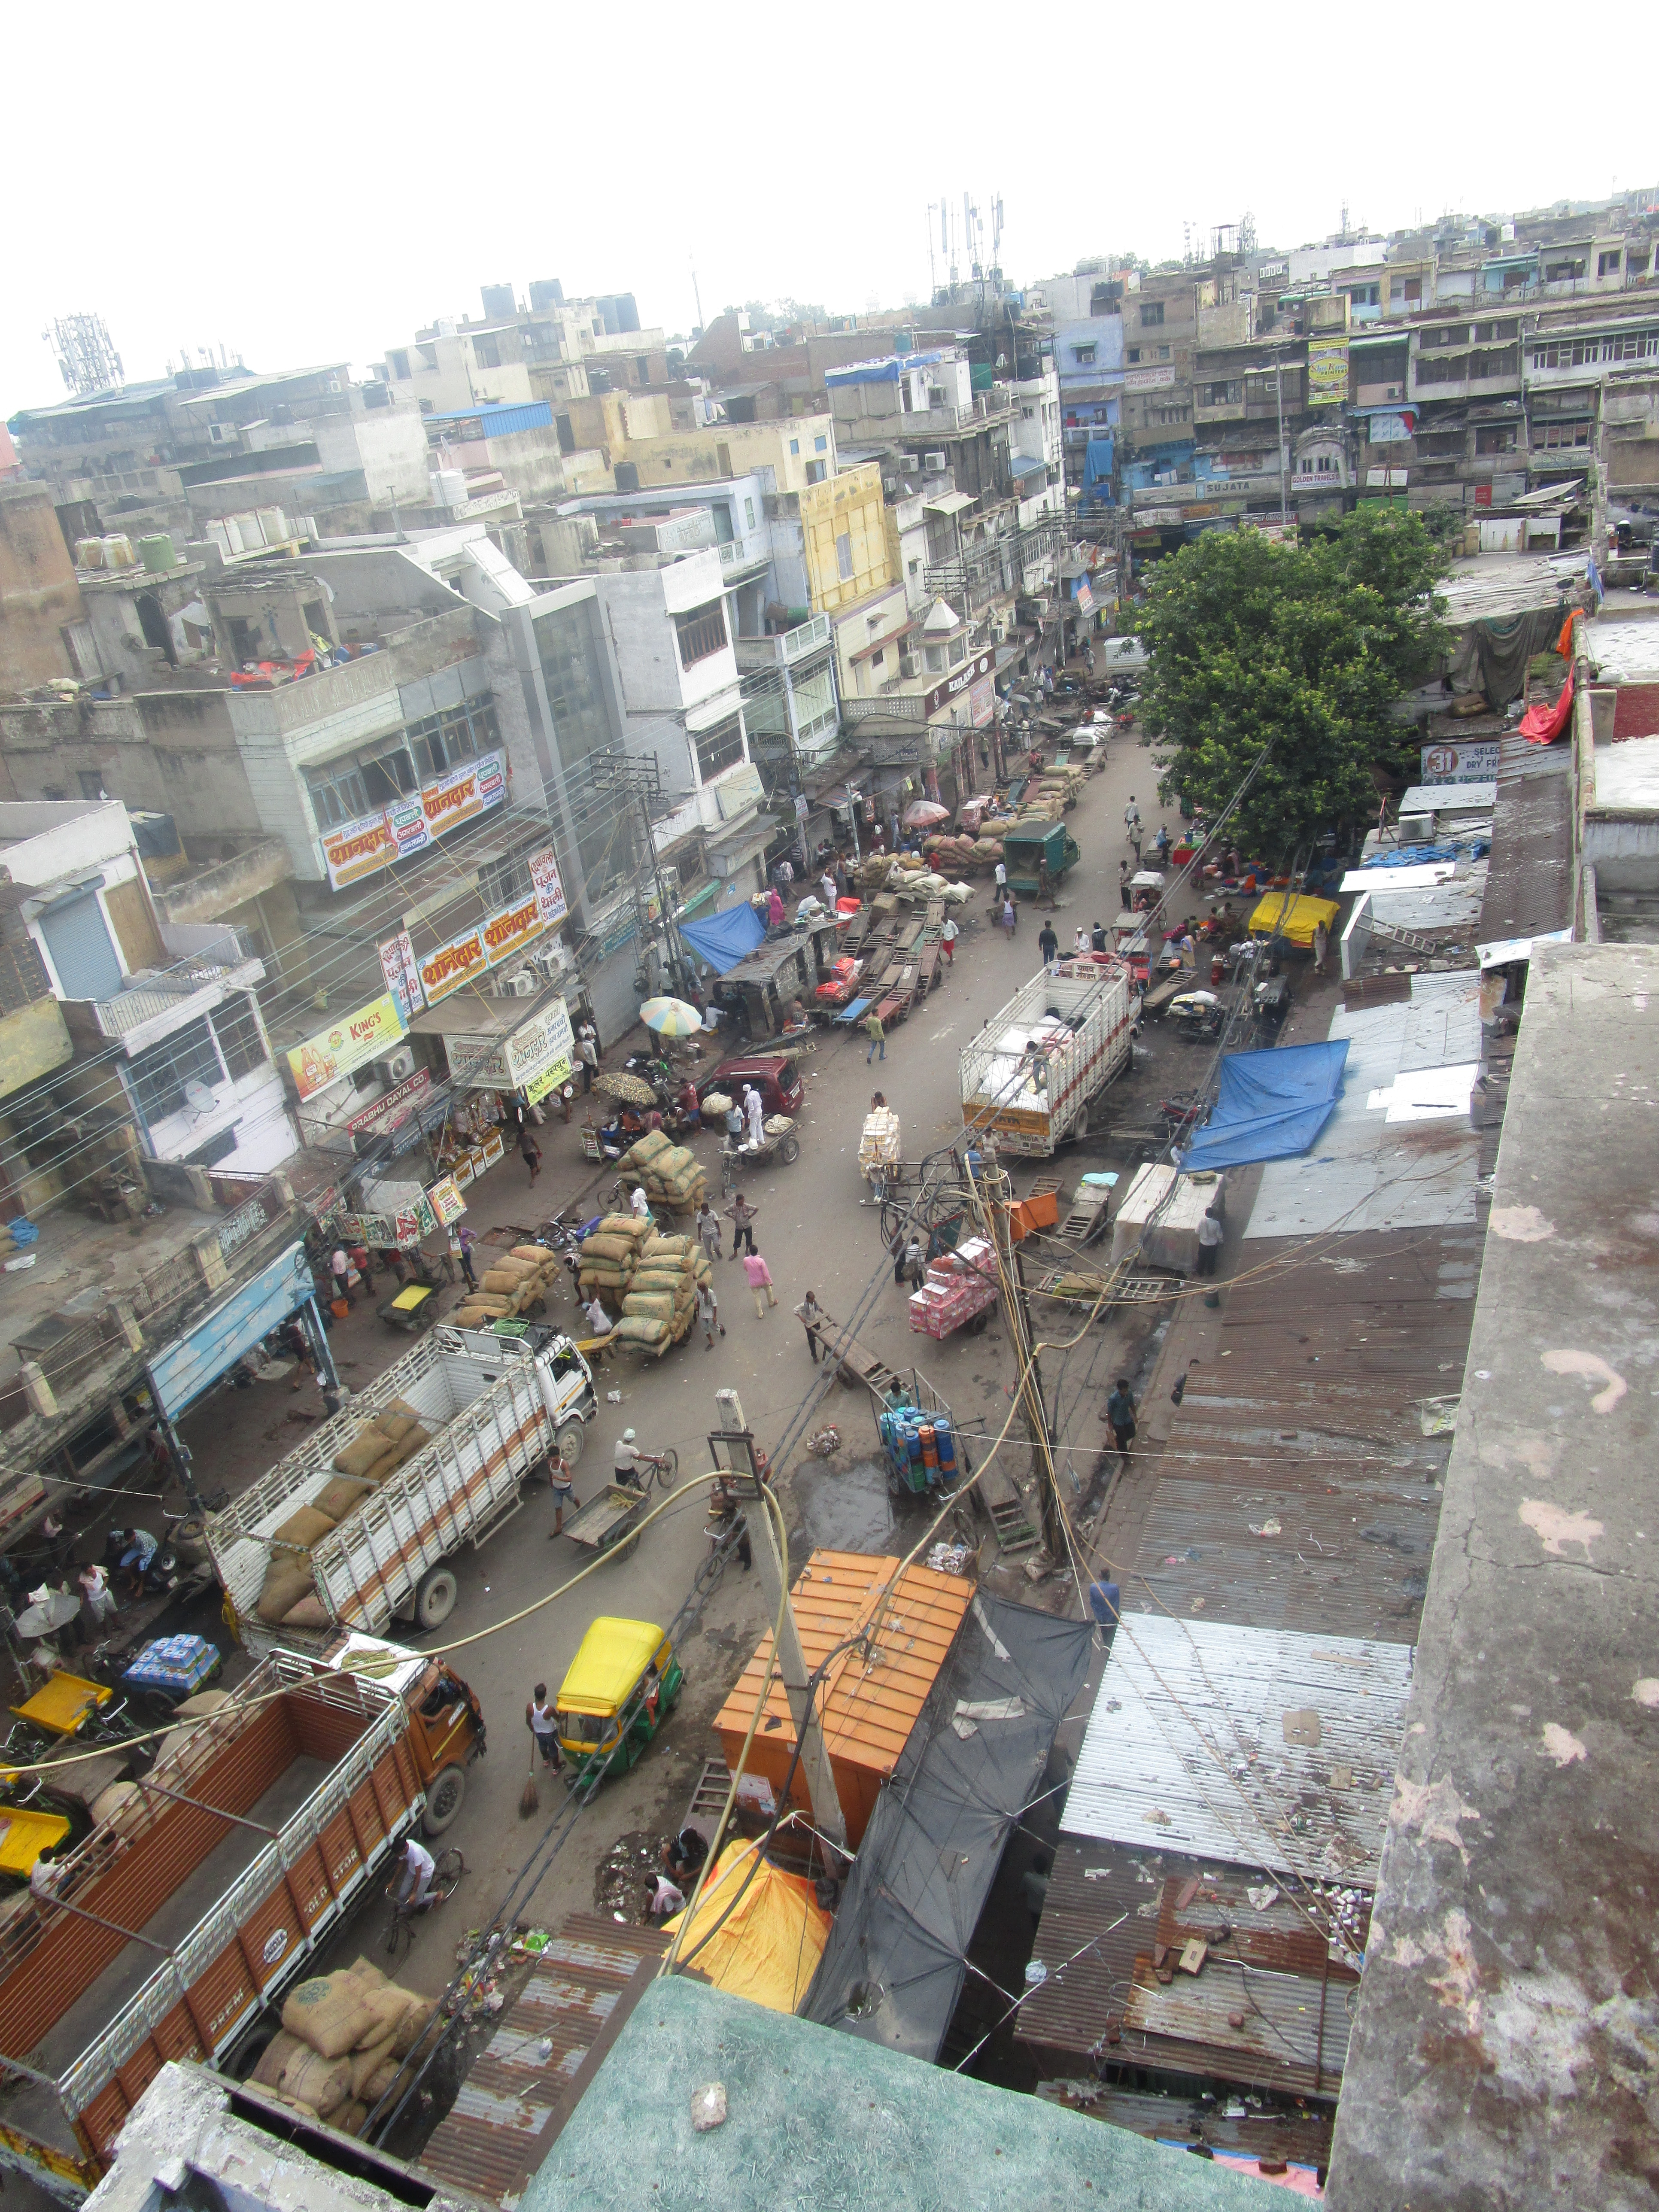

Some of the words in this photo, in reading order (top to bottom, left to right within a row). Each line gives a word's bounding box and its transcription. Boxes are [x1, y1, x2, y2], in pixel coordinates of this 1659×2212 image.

[1207, 481, 1250, 492] SUJATA
[1314, 474, 1335, 482] TRAVELS
[949, 662, 975, 693] KAILASH
[1467, 760, 1481, 769] DRY
[424, 776, 474, 819] शानदार
[329, 826, 391, 865] शानदार
[535, 868, 556, 888] पूजन
[546, 883, 553, 894] की
[541, 887, 562, 908] थाली
[485, 902, 538, 946] शानदार
[423, 938, 482, 985] शानदार
[349, 1012, 381, 1041] KING'S
[512, 1030, 547, 1068] शानदार
[352, 1103, 386, 1130] PRABHU
[386, 1084, 412, 1107] DAYAL
[413, 1074, 426, 1087] CO.
